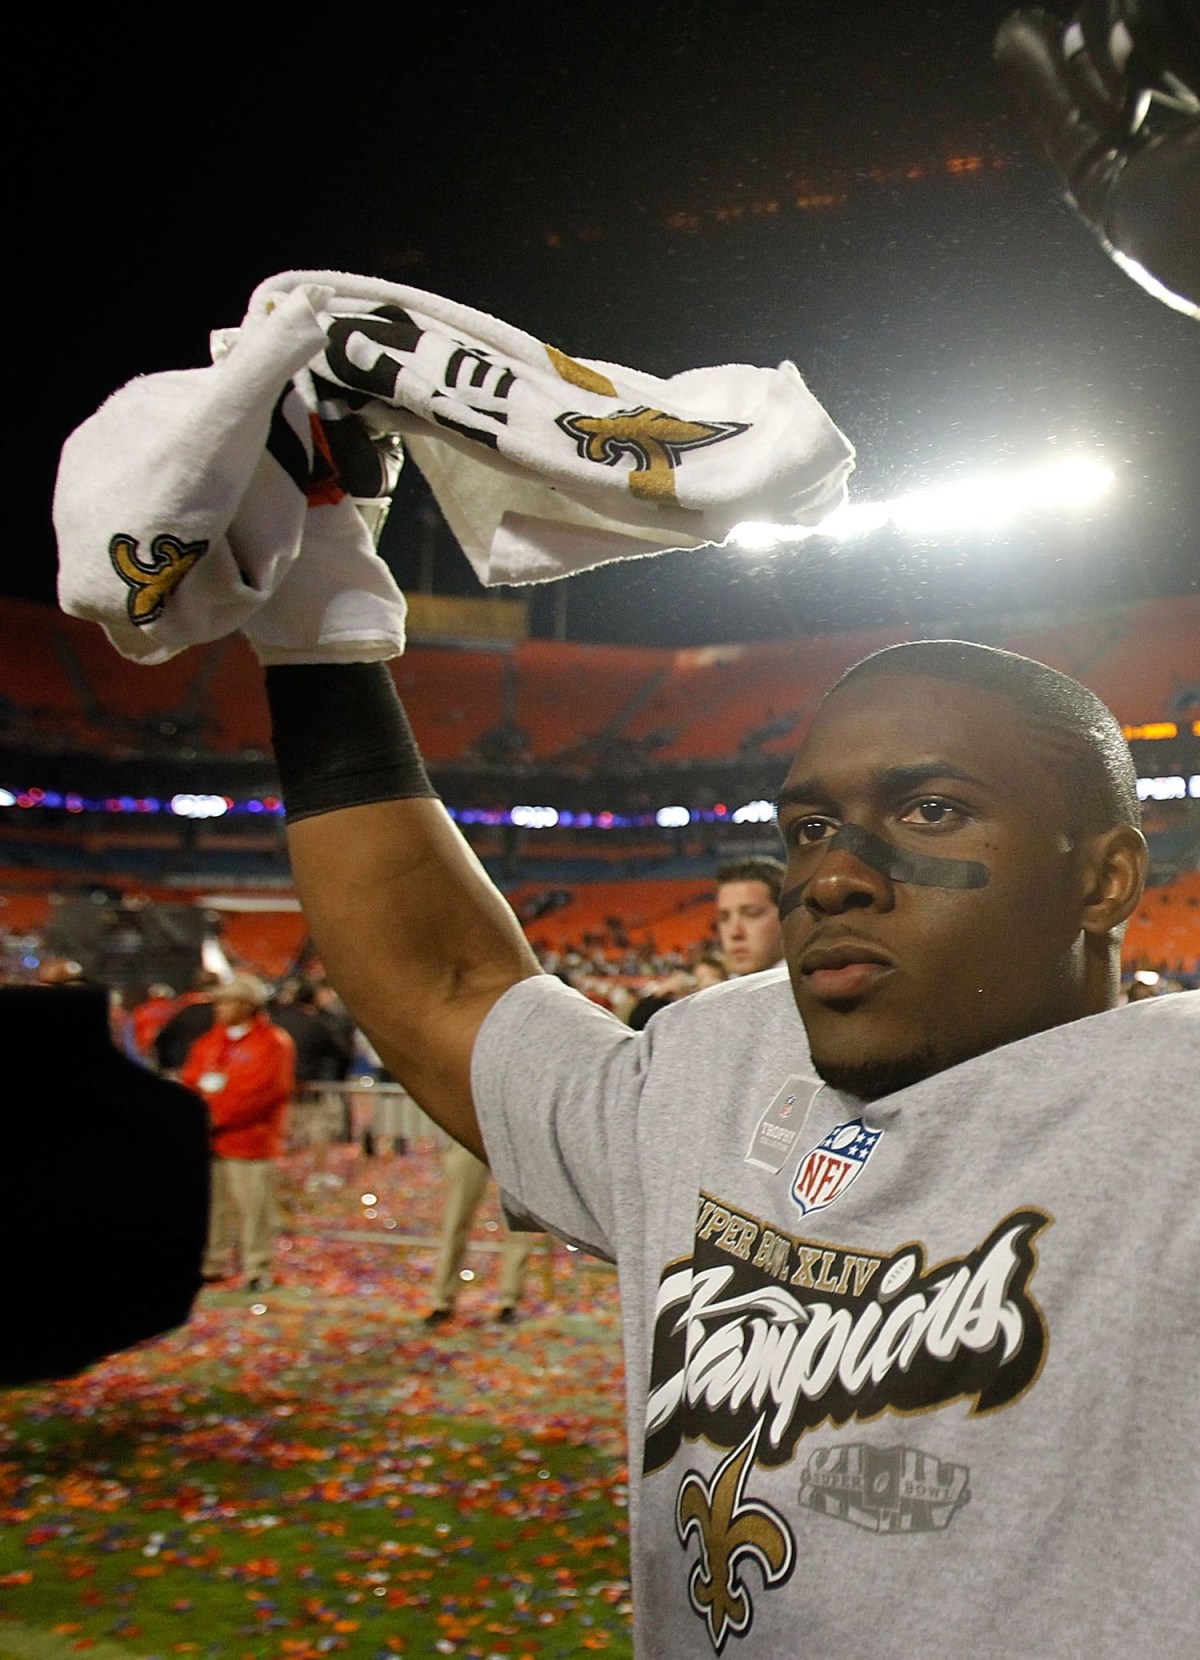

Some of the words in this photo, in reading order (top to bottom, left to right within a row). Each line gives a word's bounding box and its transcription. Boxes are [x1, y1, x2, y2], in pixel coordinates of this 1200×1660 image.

[797, 1152, 852, 1206] NFL
[696, 1198, 759, 1261] UPER
[790, 1246, 881, 1297] XLIV
